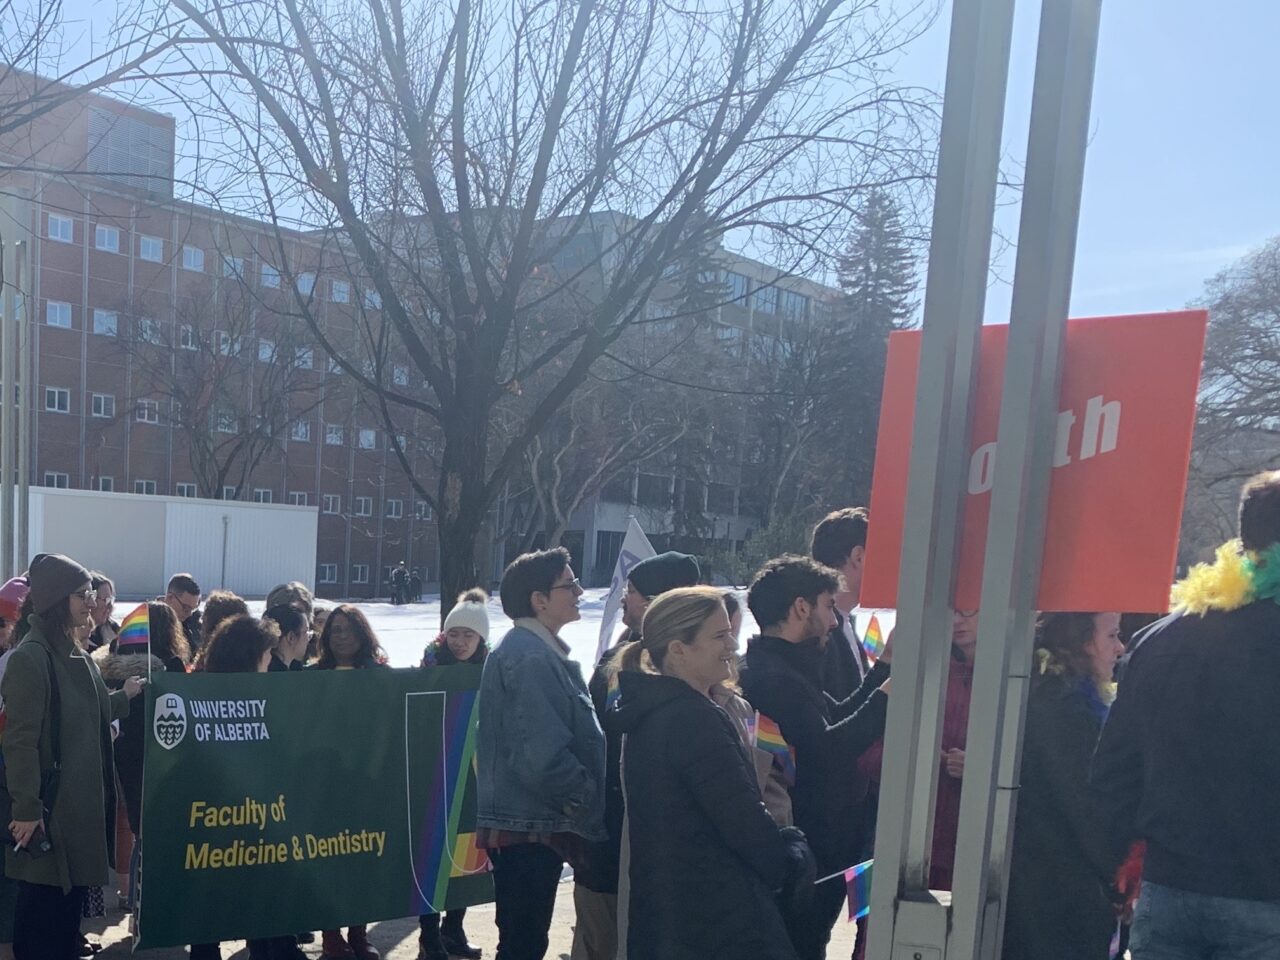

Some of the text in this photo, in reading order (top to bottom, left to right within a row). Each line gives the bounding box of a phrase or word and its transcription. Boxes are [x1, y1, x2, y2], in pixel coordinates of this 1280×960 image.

[189, 699, 266, 718] UNIVERSITY
[195, 722, 270, 741] OF ALBERTA
[189, 794, 287, 830] Faculty of
[184, 828, 386, 870] Medicine & Dentistry
